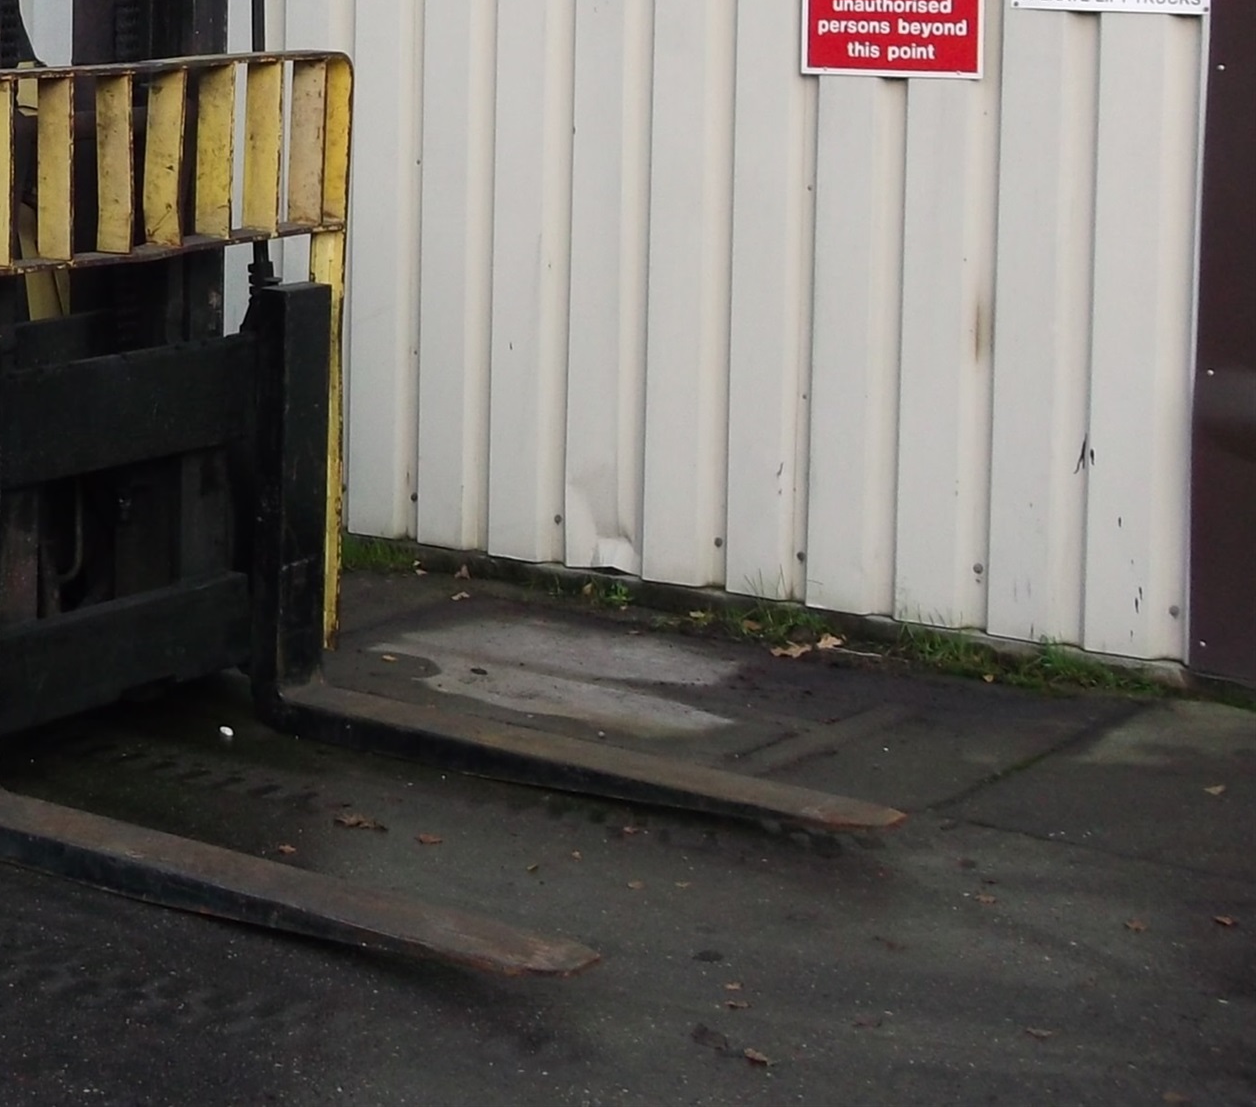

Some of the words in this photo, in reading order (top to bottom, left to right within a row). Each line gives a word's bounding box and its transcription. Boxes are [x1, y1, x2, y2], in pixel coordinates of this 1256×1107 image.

[817, 20, 890, 35] persons
[898, 19, 967, 39] beyond
[847, 42, 880, 58] this
[887, 43, 935, 61] point
